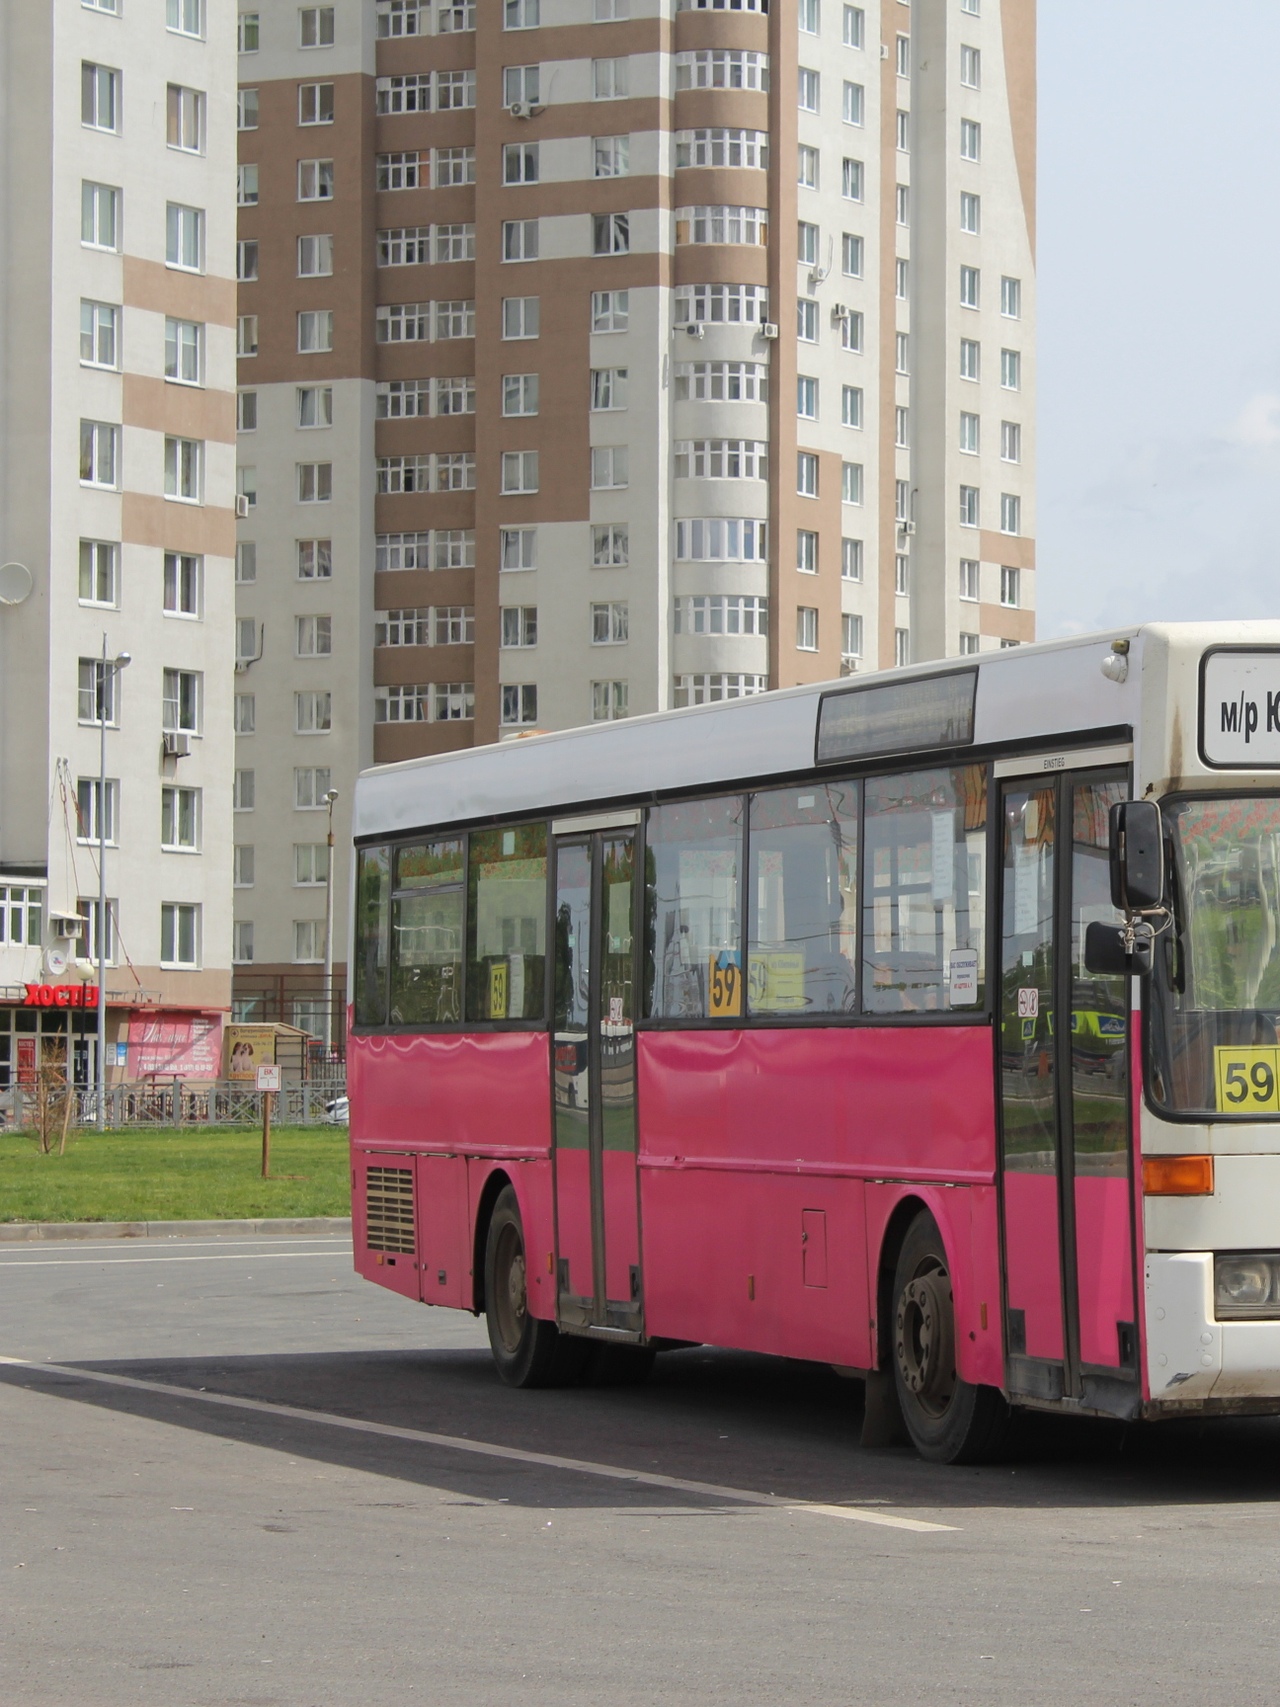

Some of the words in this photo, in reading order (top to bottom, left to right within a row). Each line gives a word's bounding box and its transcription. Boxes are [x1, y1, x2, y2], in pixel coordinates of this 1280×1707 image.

[1221, 690, 1258, 743] м/р
[1043, 757, 1065, 769] EINSTIEG
[713, 963, 735, 1007] 59
[1225, 1062, 1274, 1103] 59
